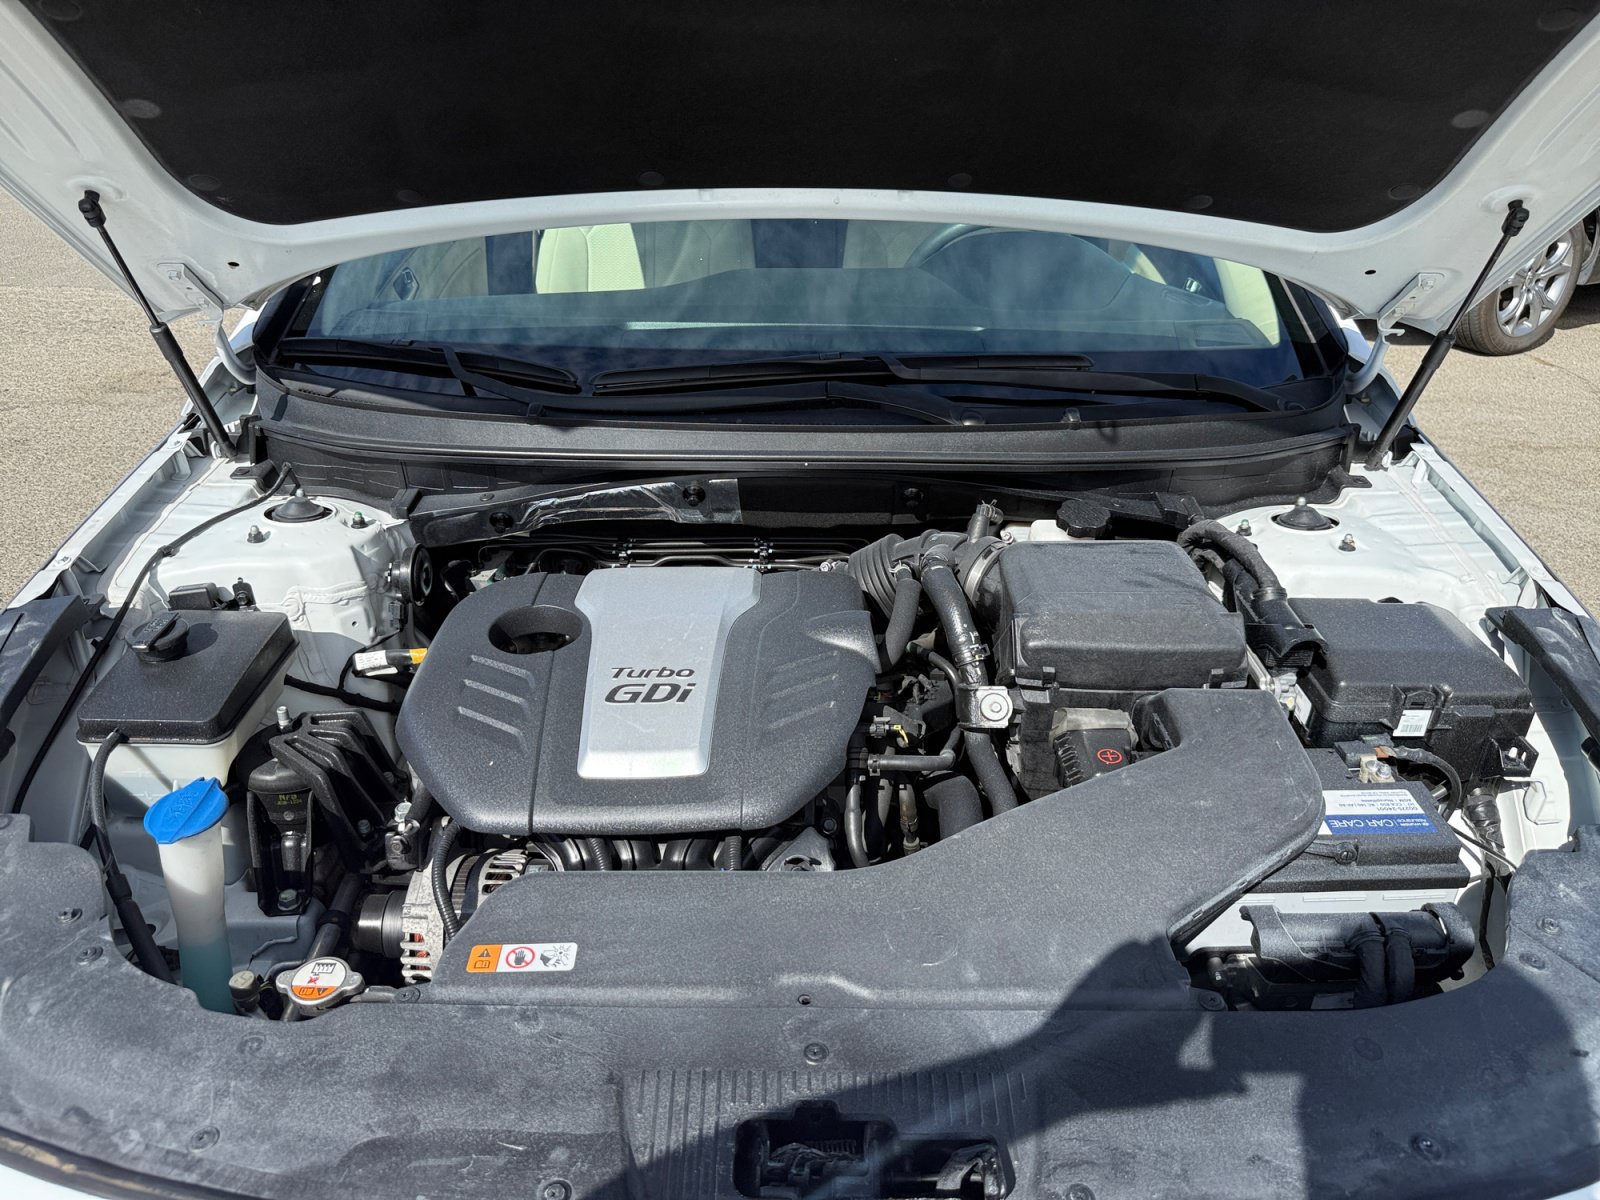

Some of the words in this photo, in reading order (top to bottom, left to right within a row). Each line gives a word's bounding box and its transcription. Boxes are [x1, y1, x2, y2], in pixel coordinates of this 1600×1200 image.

[611, 666, 695, 679] Turbo
[604, 682, 697, 703] GDi
[1329, 819, 1364, 828] CARE
[1366, 819, 1394, 828] CAR
